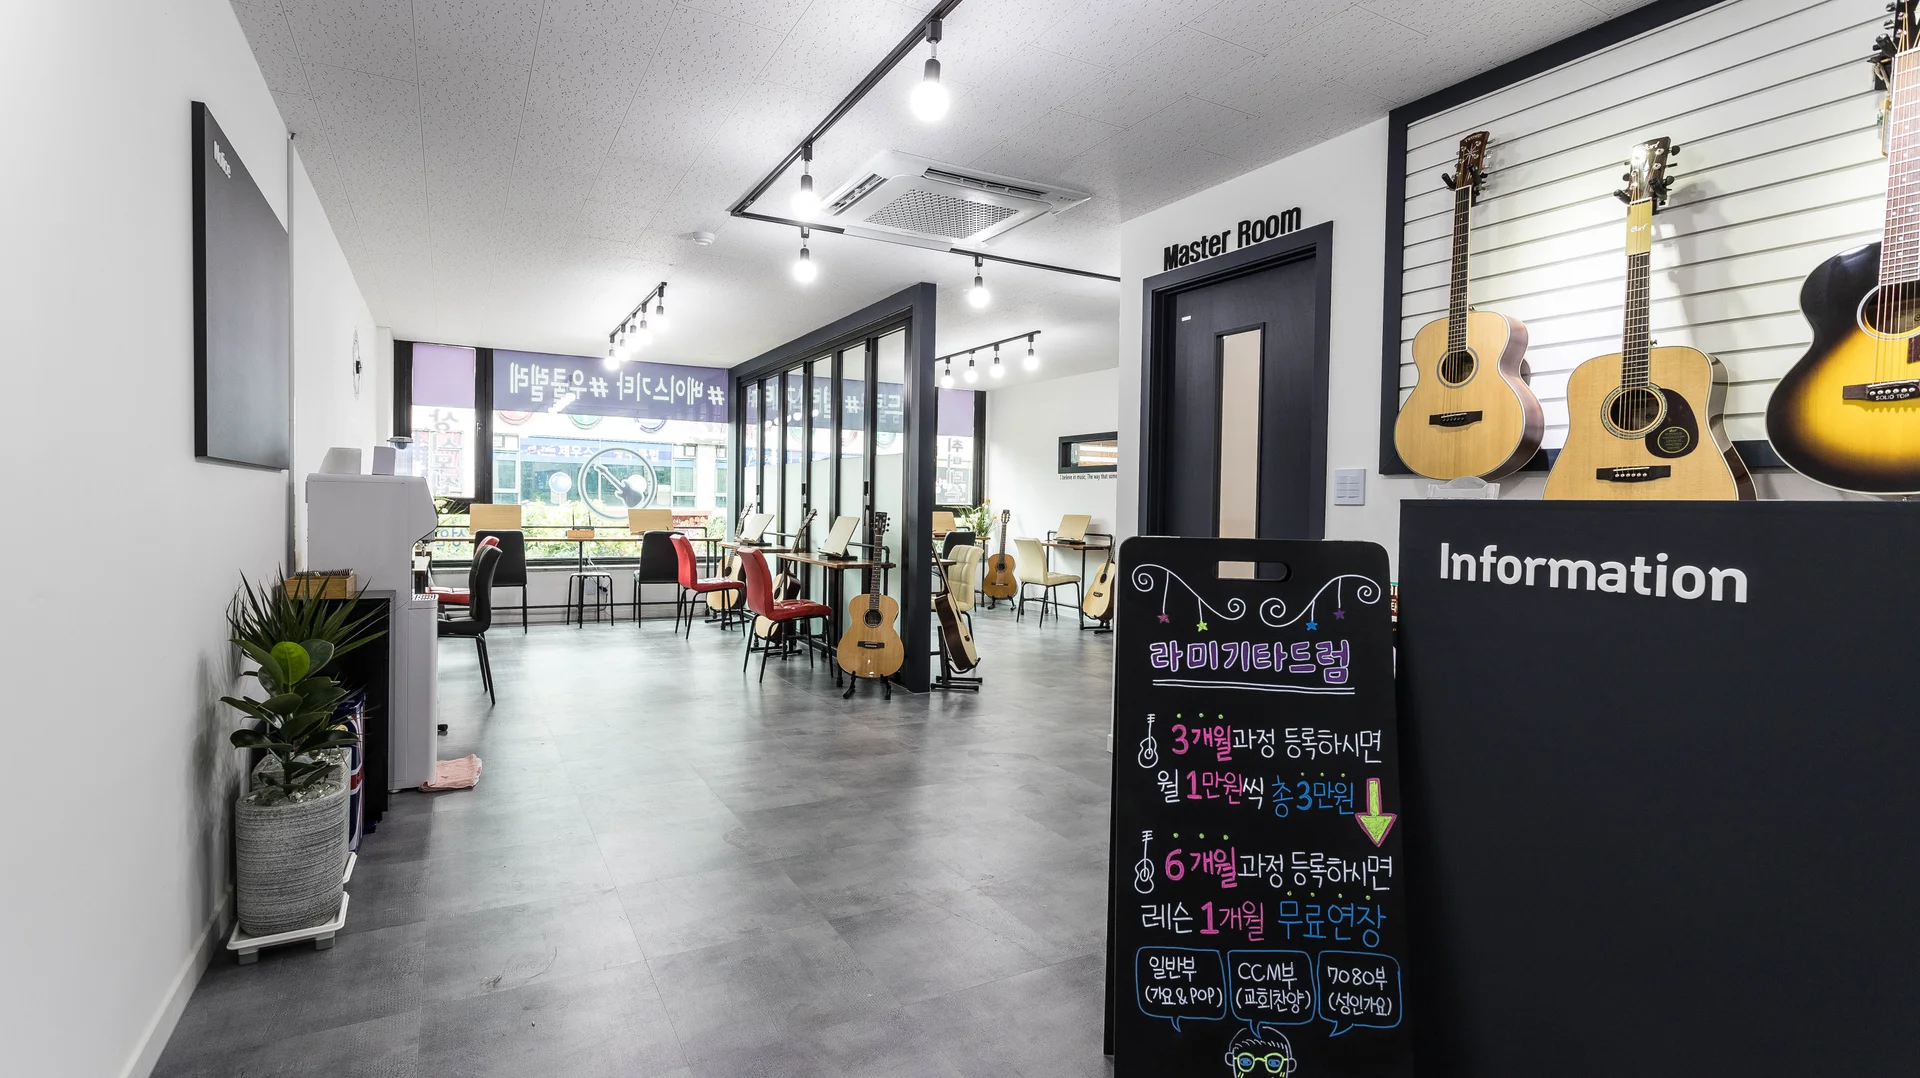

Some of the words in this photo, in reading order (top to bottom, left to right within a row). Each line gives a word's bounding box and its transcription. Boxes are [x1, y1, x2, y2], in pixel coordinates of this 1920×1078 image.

[213, 140, 232, 179] Notice
[1163, 229, 1231, 271] Master
[1237, 206, 1302, 248] Room
[1440, 542, 1748, 603] Information
[1149, 639, 1350, 684] 라미기타드럼
[1284, 727, 1382, 764] 등록하시면
[1157, 769, 1180, 803] 월
[1291, 852, 1393, 891] 등록하시면
[1141, 902, 1193, 934] 레슨
[1199, 900, 1265, 942] 1개월
[1278, 900, 1387, 948] 무료연장
[1149, 956, 1197, 982] 일반부
[1238, 962, 1298, 990] CCM부
[1327, 966, 1388, 990] 7080부
[1235, 988, 1311, 1014] (교회찬양)
[1328, 992, 1392, 1017] (성인가요)
